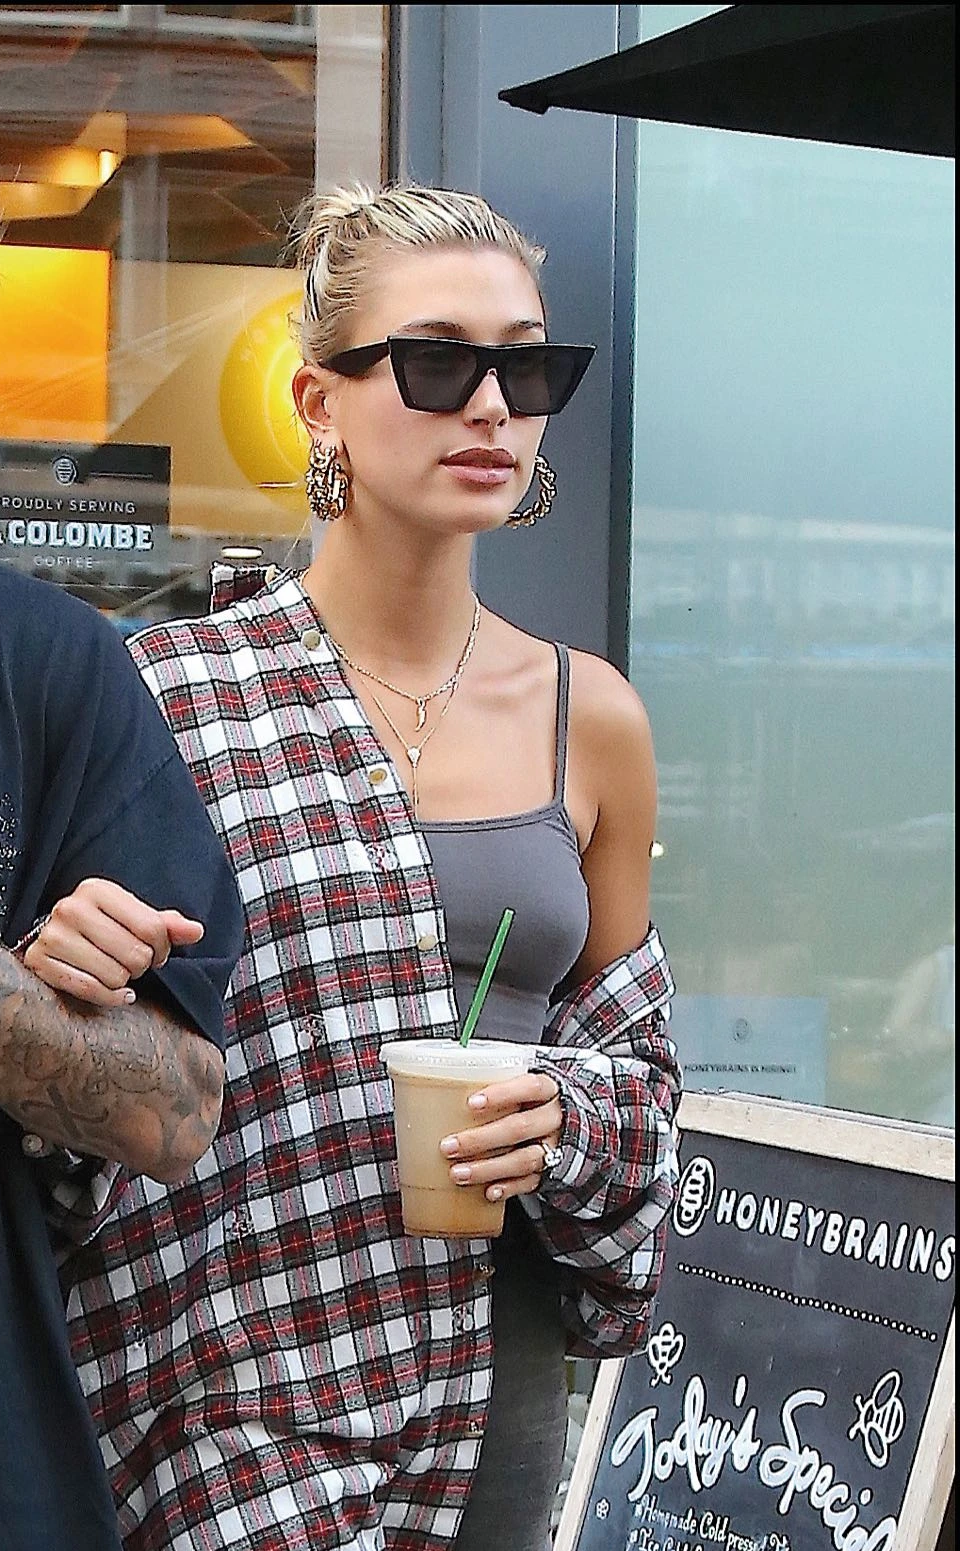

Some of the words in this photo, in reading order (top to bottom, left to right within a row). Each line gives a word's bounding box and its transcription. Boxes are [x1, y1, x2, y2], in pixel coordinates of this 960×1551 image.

[69, 499, 136, 514] SERVING
[8, 520, 154, 549] COLOMBE
[33, 556, 93, 569] COFFEE
[715, 1188, 956, 1281] HONEYBRAINS
[611, 1375, 761, 1502] Today's
[700, 1511, 729, 1542] Cold
